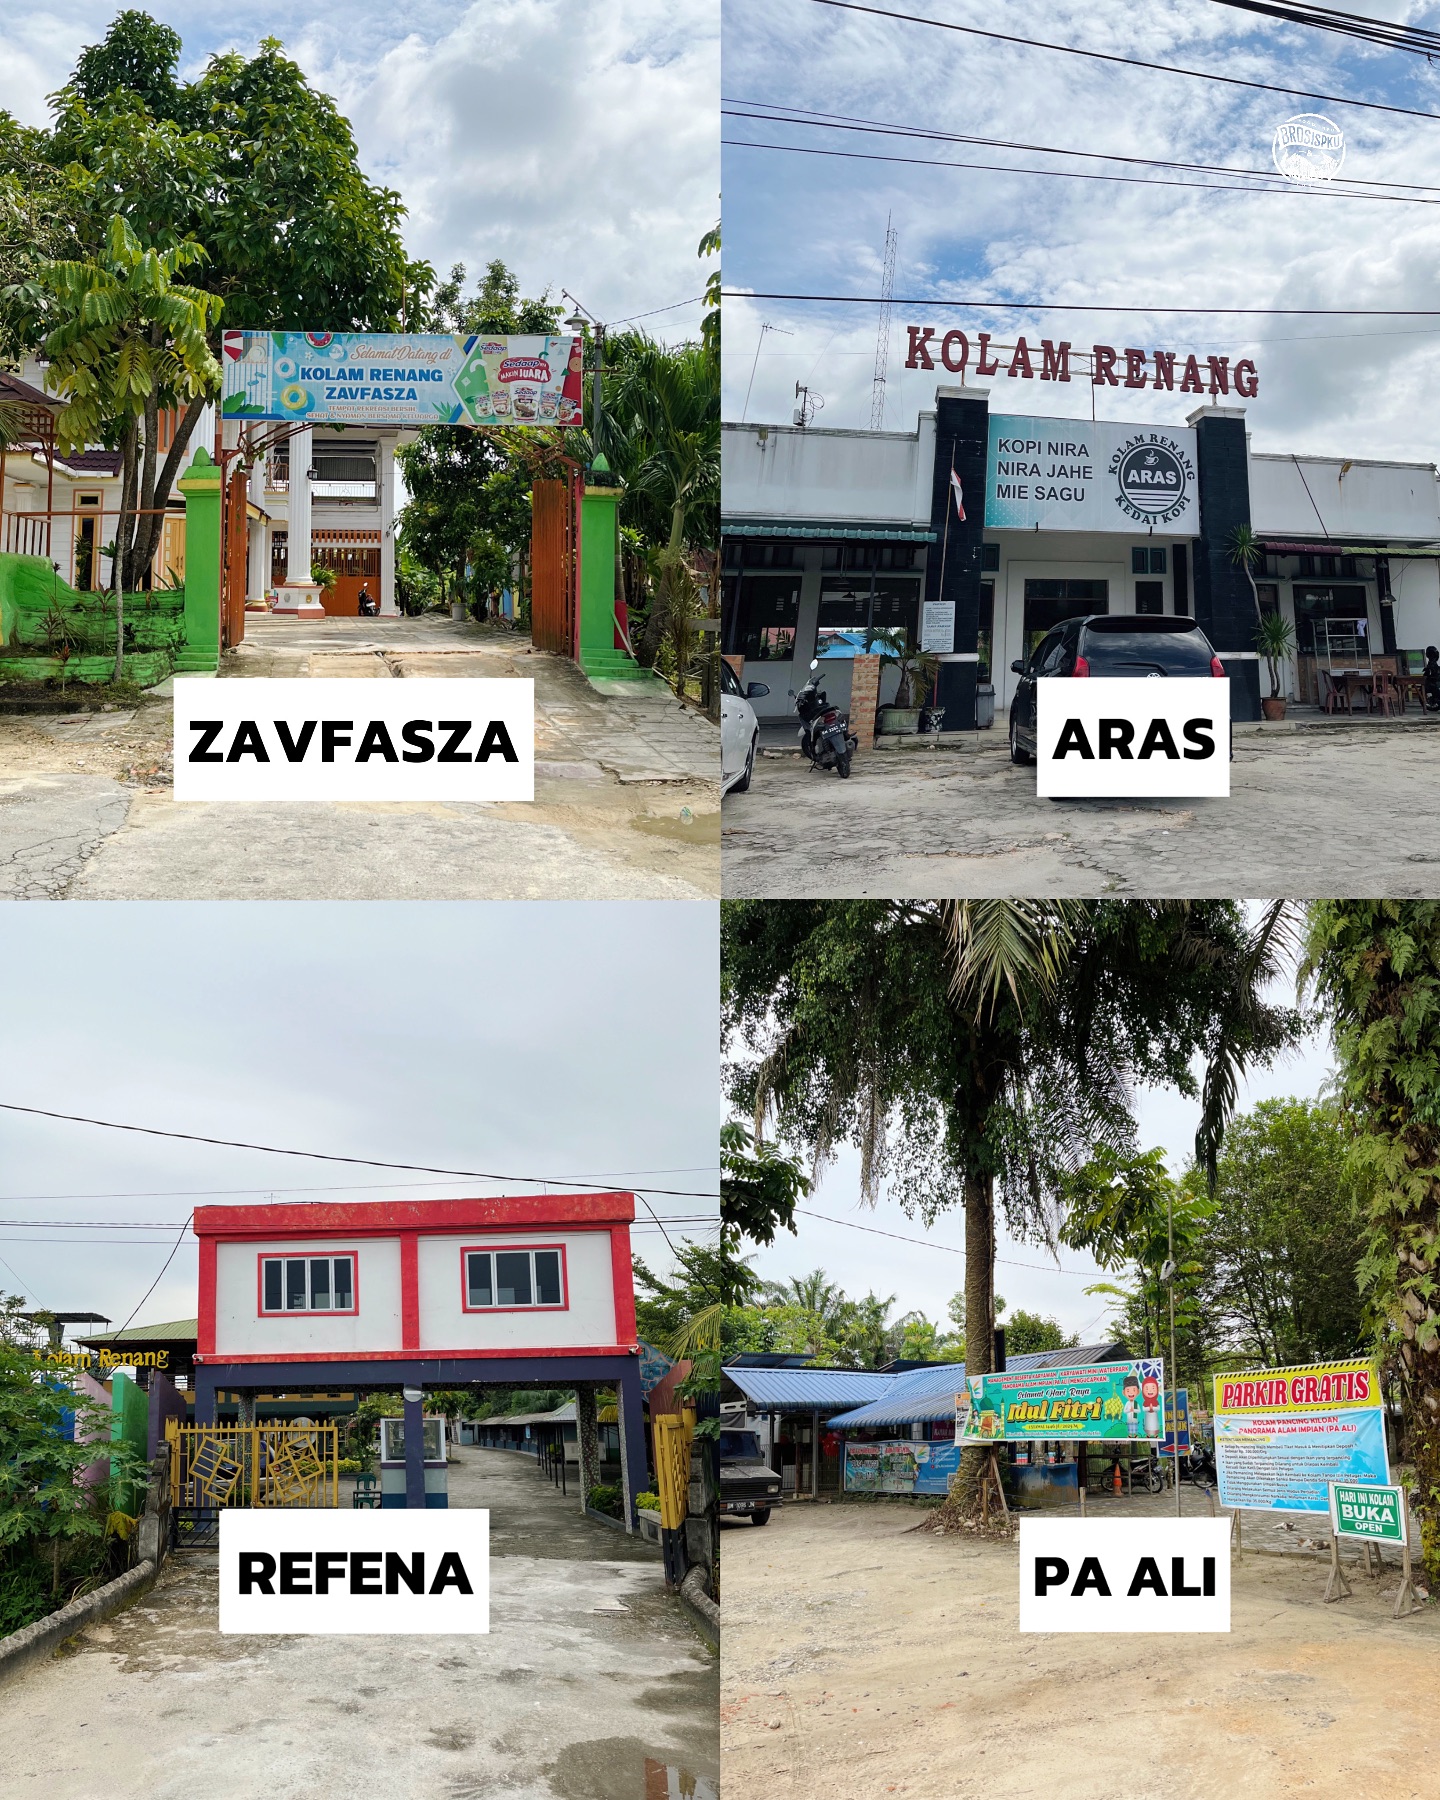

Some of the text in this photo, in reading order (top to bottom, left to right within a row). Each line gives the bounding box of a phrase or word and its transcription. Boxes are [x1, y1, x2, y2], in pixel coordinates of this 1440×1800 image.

[350, 344, 453, 365] Selamat Datang di
[480, 344, 507, 352] Sedaap
[503, 359, 540, 368] Sedaap
[905, 325, 1259, 398] KOLAM RENANG
[300, 367, 443, 382] KOLAM RENANG
[500, 368, 549, 382] MAKIN JUARA
[325, 386, 418, 401] ZAVFASZA
[998, 438, 1089, 458] KOPI NIRA
[1108, 433, 1195, 481] KOLAM RENANG
[997, 461, 1093, 480] NIRA JAHE
[1127, 469, 1177, 485] ARAS
[997, 483, 1085, 502] MIE SAGU
[1114, 494, 1191, 525] KEDAI KOPI
[99, 1348, 170, 1369] Renang
[1099, 1365, 1129, 1374] WATERPARK
[1017, 1387, 1090, 1400] Selamat Hari Raya
[1222, 1371, 1370, 1409] PARKIR GRATIS
[1007, 1397, 1102, 1422] Idul Fitri
[1310, 1416, 1339, 1424] KILOAN
[1326, 1425, 1339, 1433] (PA
[1341, 1424, 1357, 1433] ALI)
[1339, 1490, 1395, 1507] HARI INI KOLAM
[1341, 1503, 1395, 1523] BUKA
[1354, 1522, 1383, 1533] OPEN
